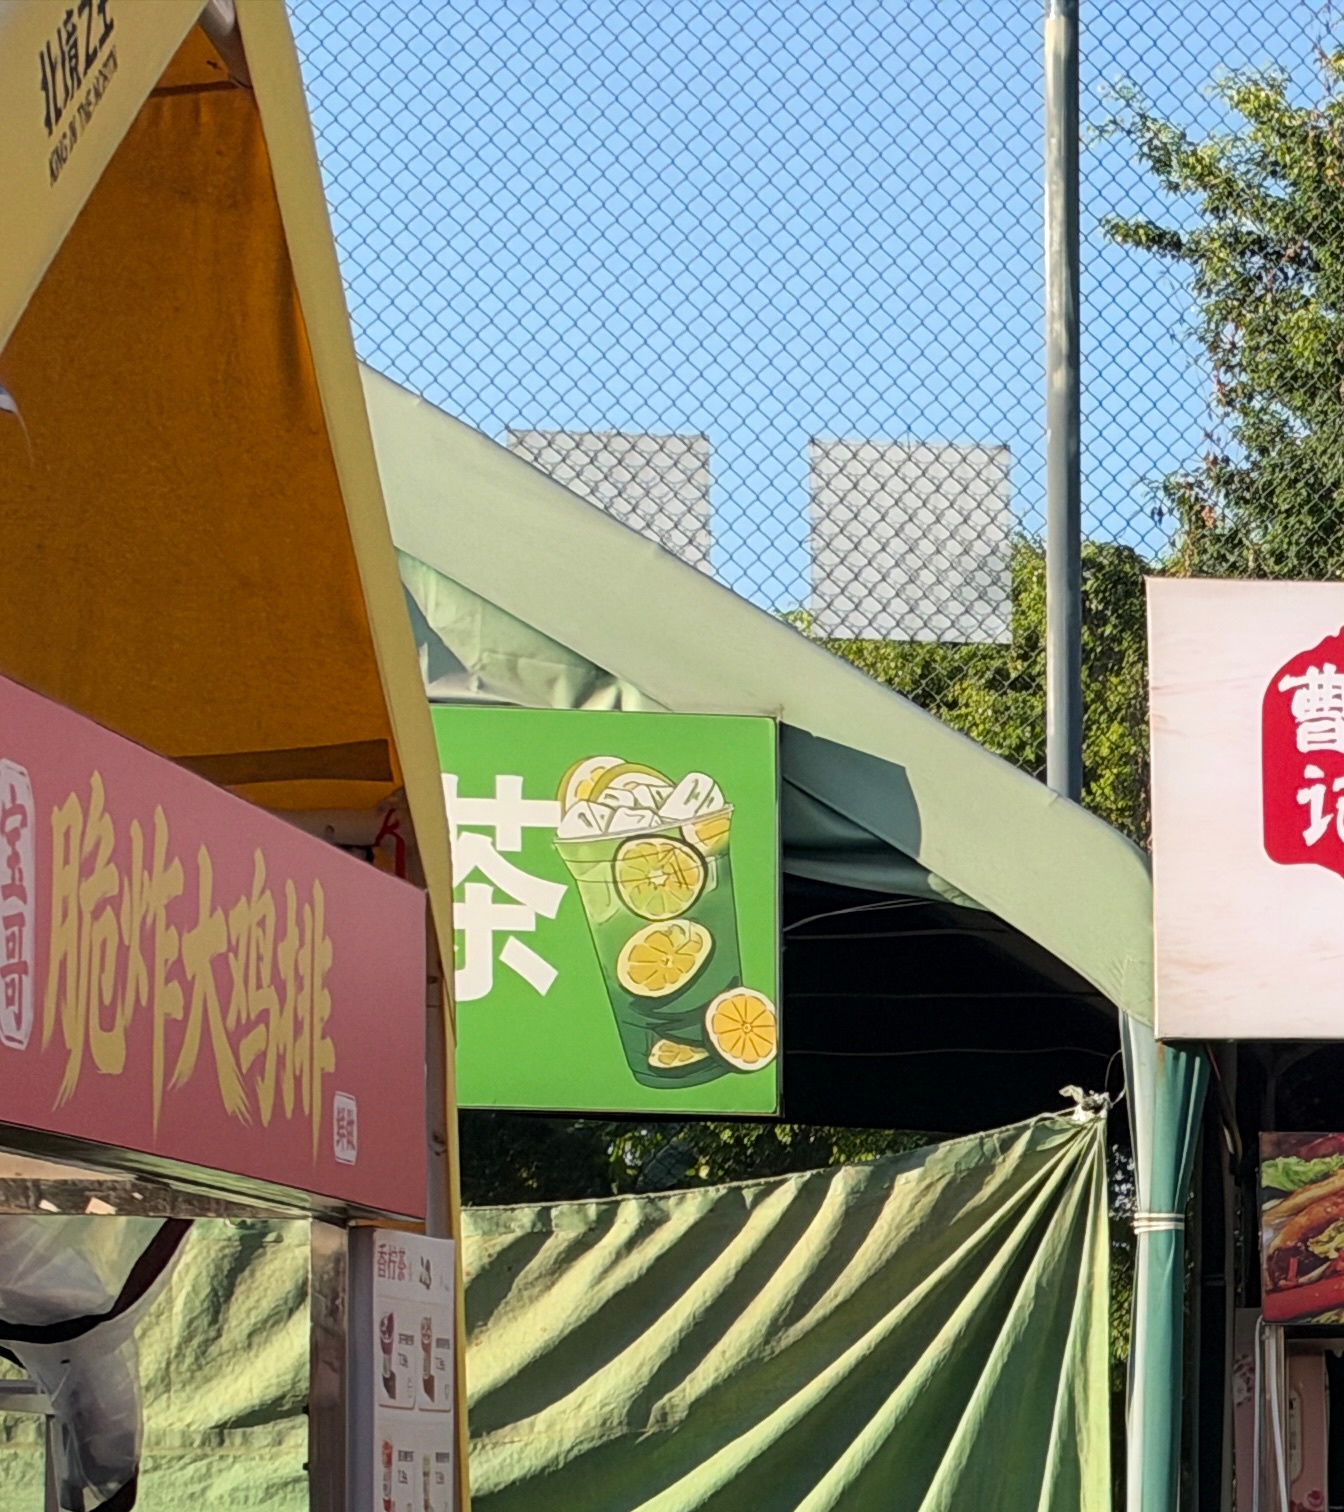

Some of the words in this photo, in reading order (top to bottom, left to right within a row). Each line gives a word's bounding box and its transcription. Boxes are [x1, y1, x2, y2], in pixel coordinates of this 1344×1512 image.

[41, 770, 337, 1169] 脆炸大鸡排
[443, 774, 569, 1002] 茶
